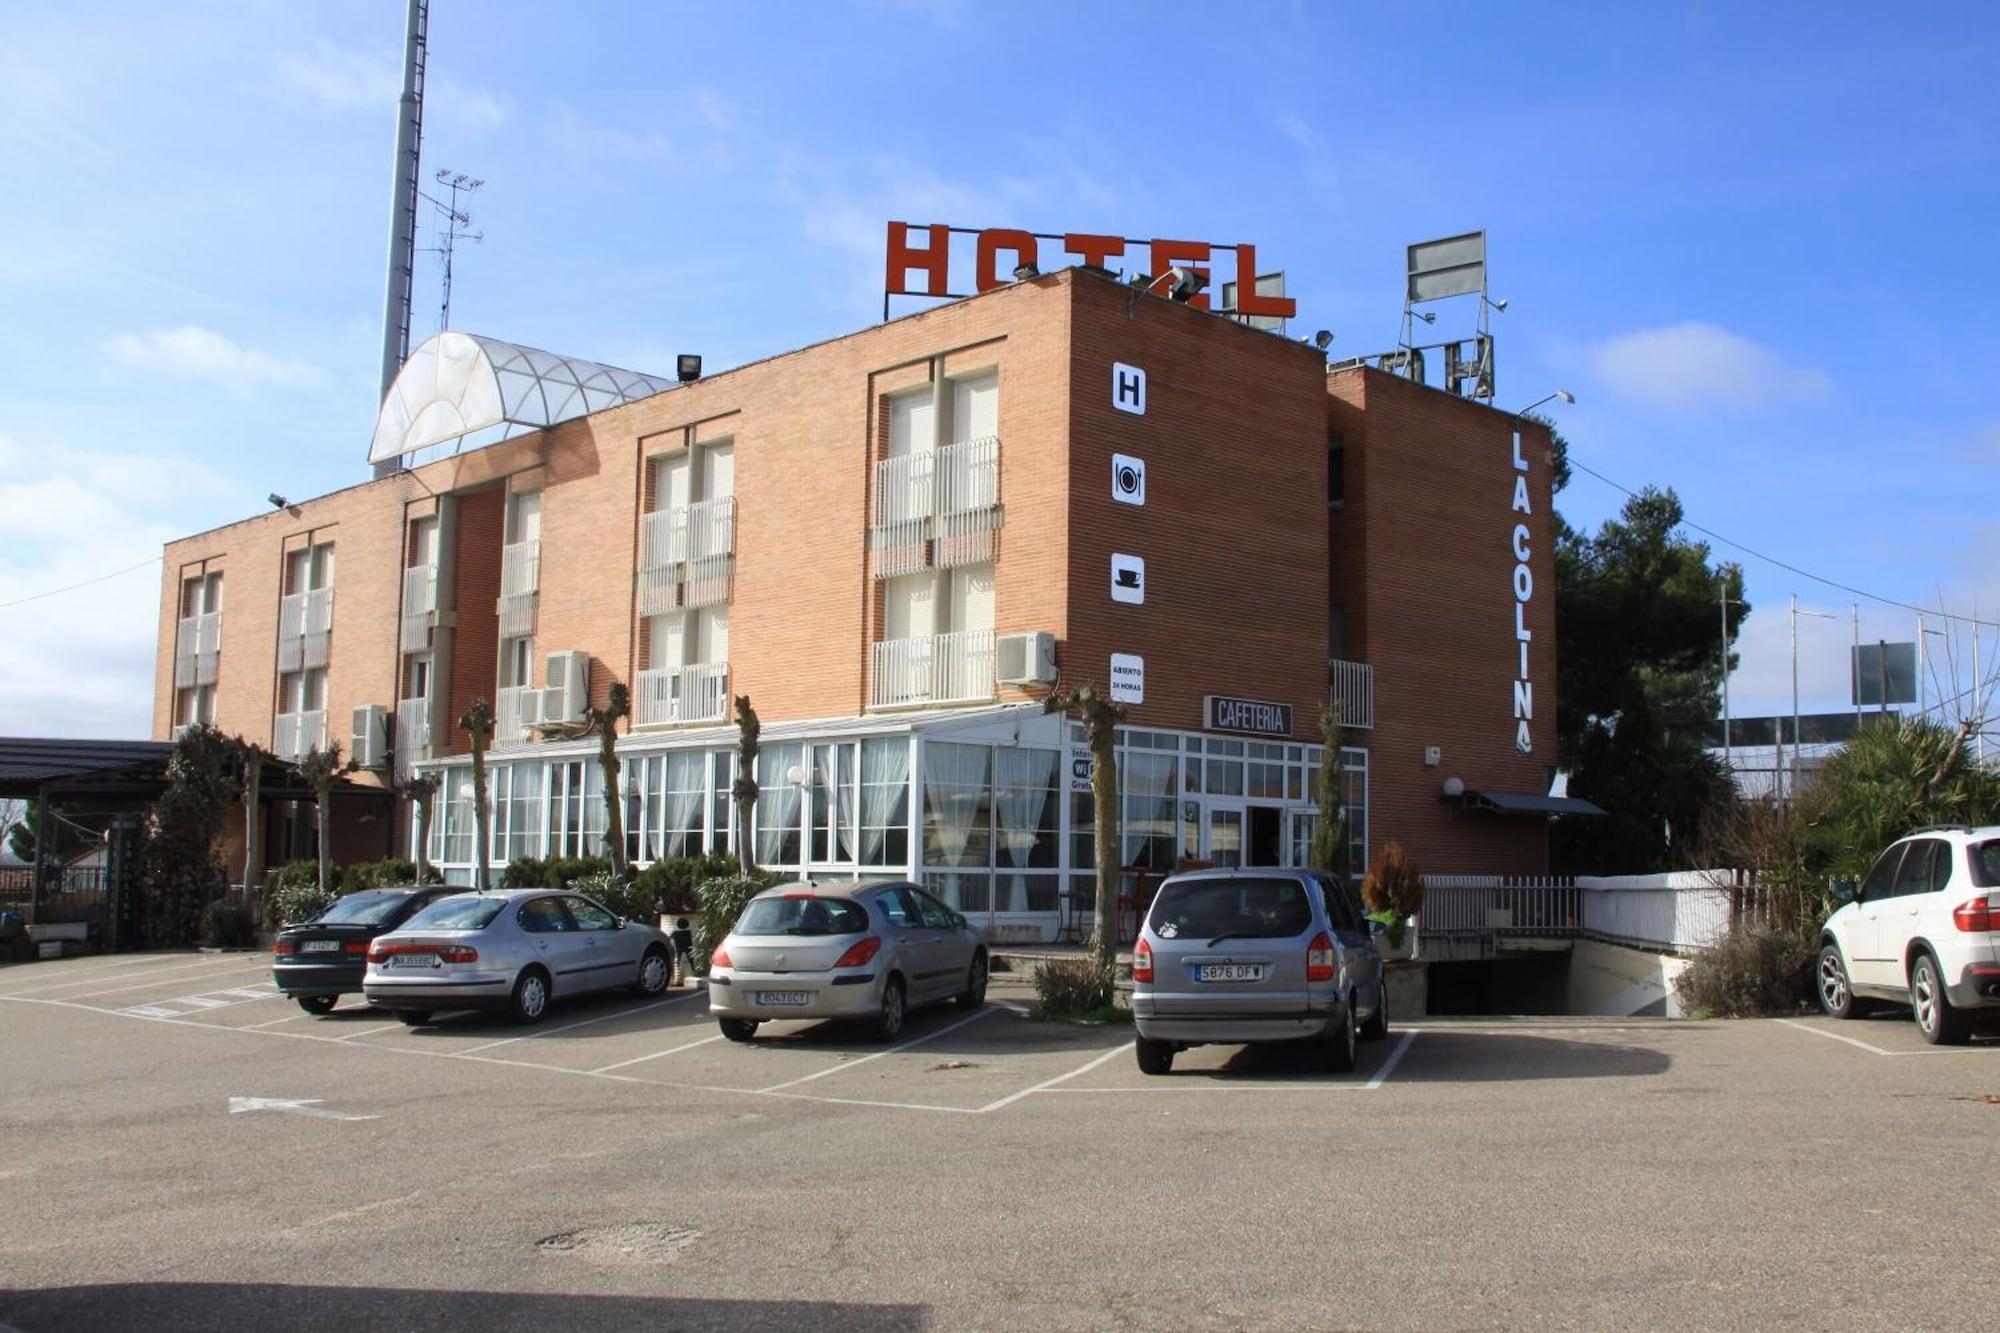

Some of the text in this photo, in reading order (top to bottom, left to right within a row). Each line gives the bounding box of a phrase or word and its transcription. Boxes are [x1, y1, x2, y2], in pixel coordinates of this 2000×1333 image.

[886, 221, 1297, 319] HOTEL
[1119, 371, 1140, 406] H
[1512, 432, 1534, 754] LA COLINA
[1113, 665, 1142, 676] ABIERTO
[1121, 683, 1141, 691] HORAS
[1217, 700, 1284, 732] CAFETERIA
